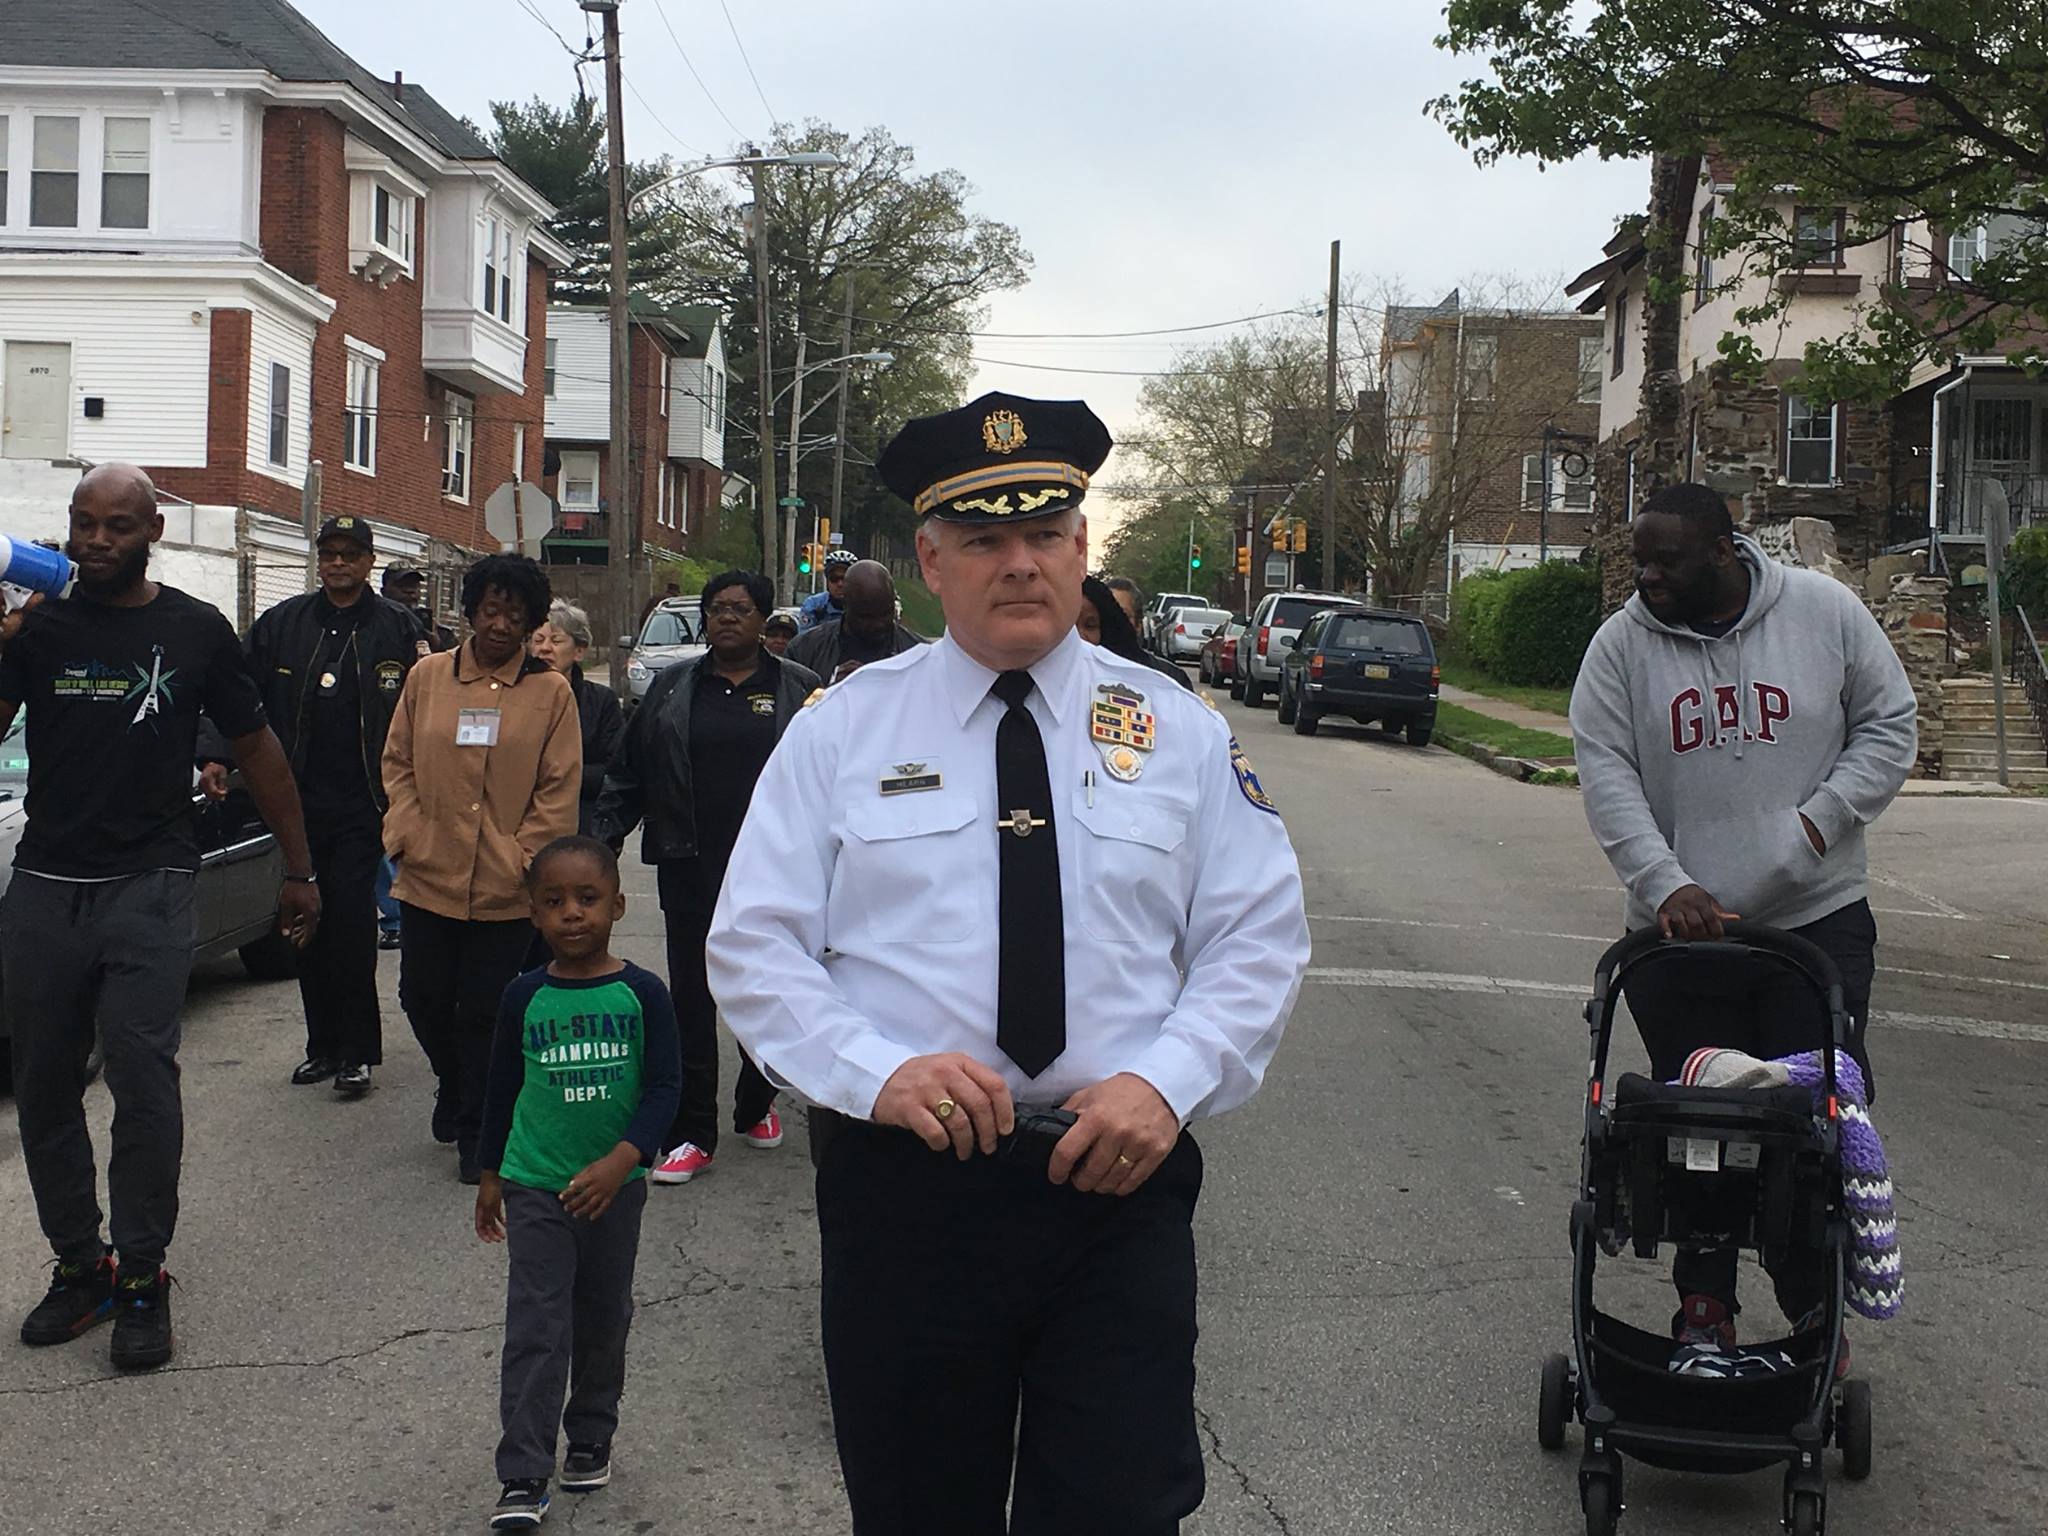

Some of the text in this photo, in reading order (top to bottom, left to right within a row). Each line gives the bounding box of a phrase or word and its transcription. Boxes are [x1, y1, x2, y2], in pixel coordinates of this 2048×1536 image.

[1669, 680, 1792, 756] GAP
[529, 1014, 639, 1050] ALL-STATE
[540, 1041, 630, 1064] CHAMPIONS
[549, 1065, 624, 1087] ATHLETIC
[564, 1085, 612, 1103] DEPT.
